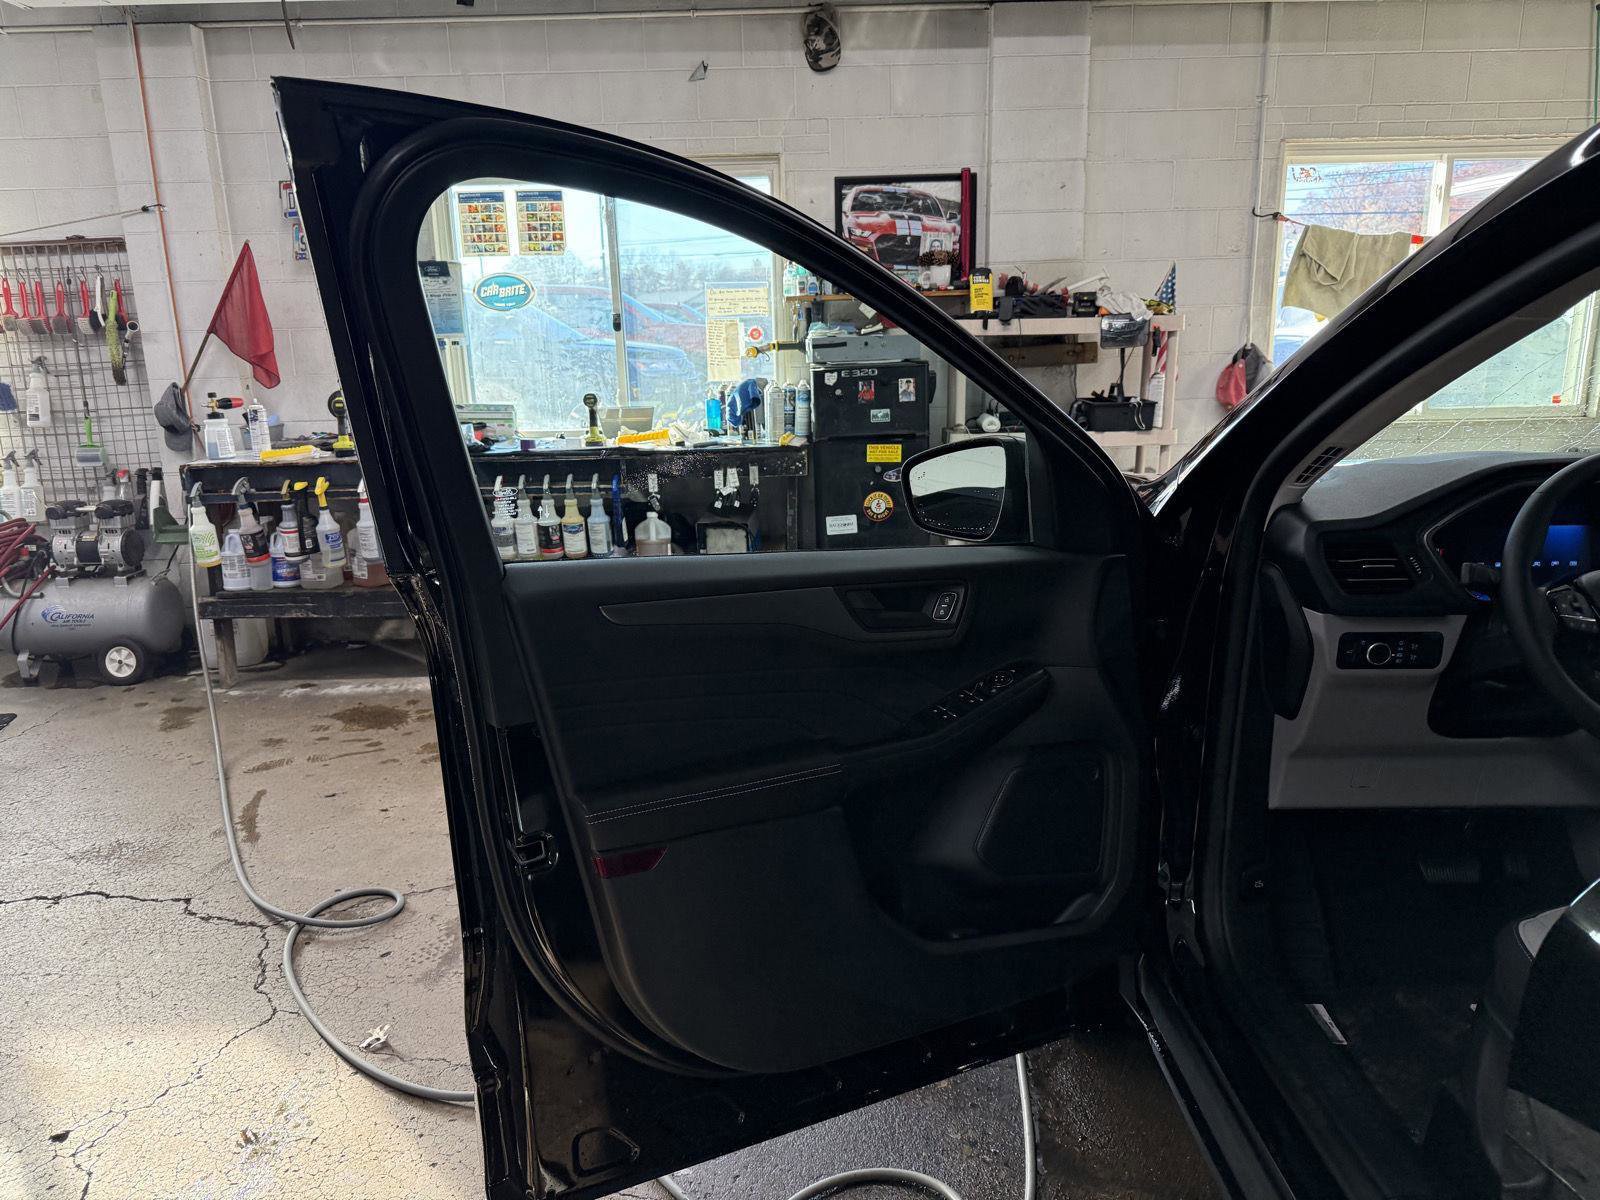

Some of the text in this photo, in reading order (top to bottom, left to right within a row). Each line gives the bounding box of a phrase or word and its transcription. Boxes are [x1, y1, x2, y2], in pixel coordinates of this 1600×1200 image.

[480, 283, 526, 298] CAR BRITE
[51, 612, 95, 621] CALIFORNIA
